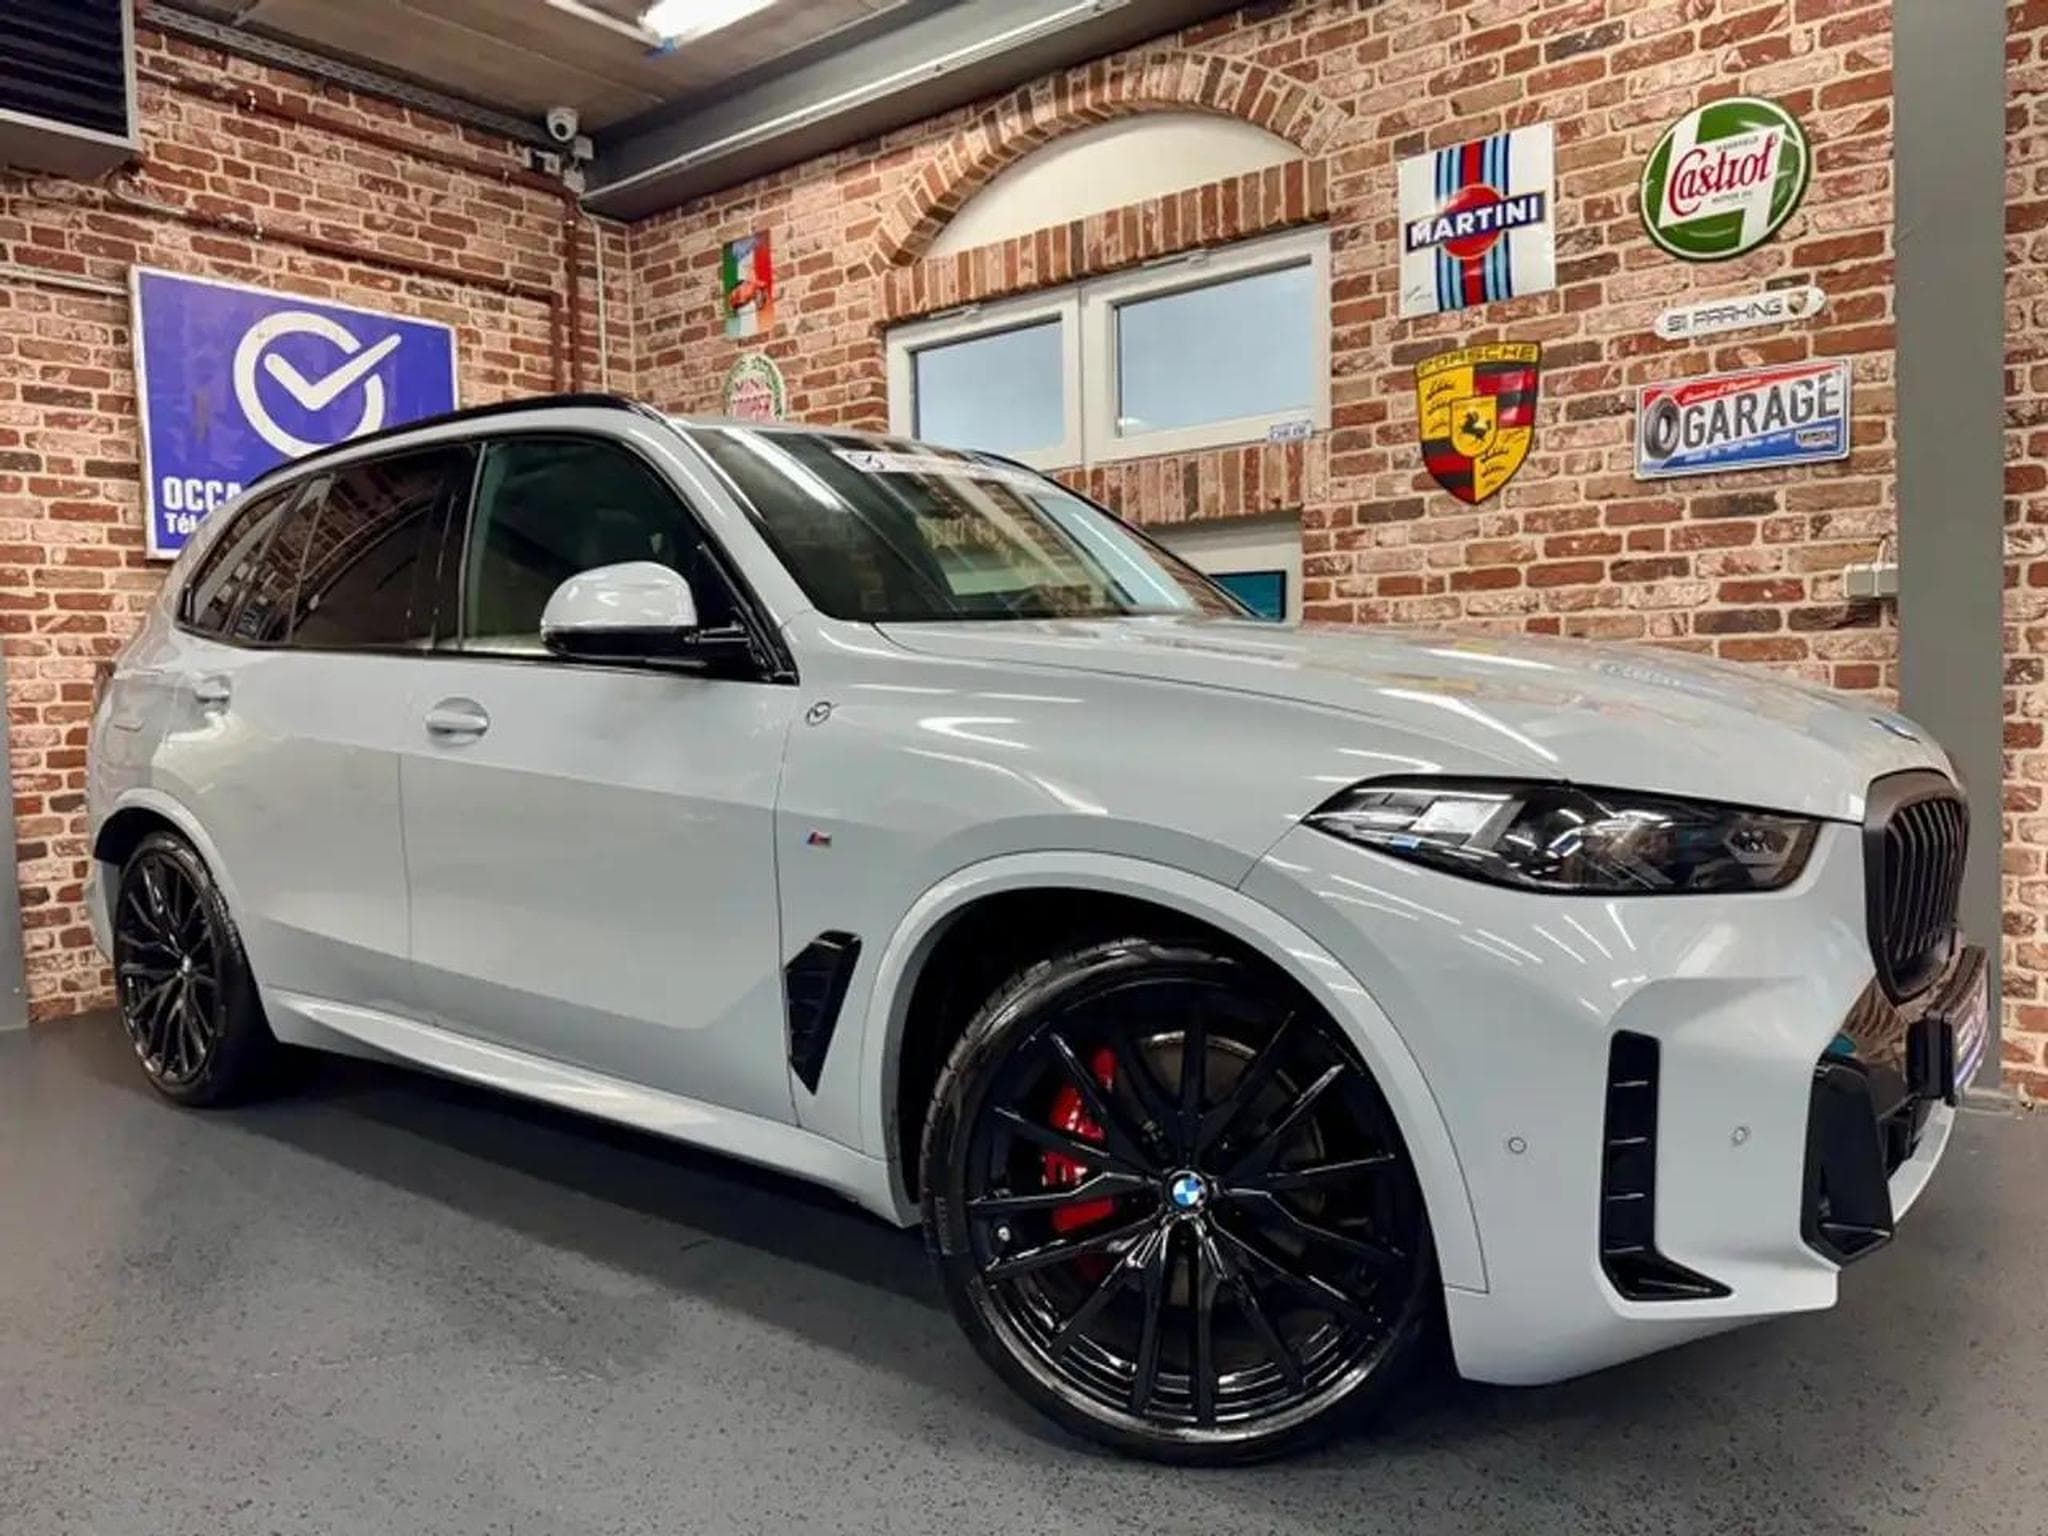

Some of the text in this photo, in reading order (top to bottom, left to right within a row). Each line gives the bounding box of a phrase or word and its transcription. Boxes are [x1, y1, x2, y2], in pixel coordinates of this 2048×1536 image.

[1669, 132, 1776, 217] Castrol
[1410, 196, 1538, 247] MARTINI
[1418, 344, 1536, 376] PORSCHE
[1683, 371, 1841, 449] GARAGE
